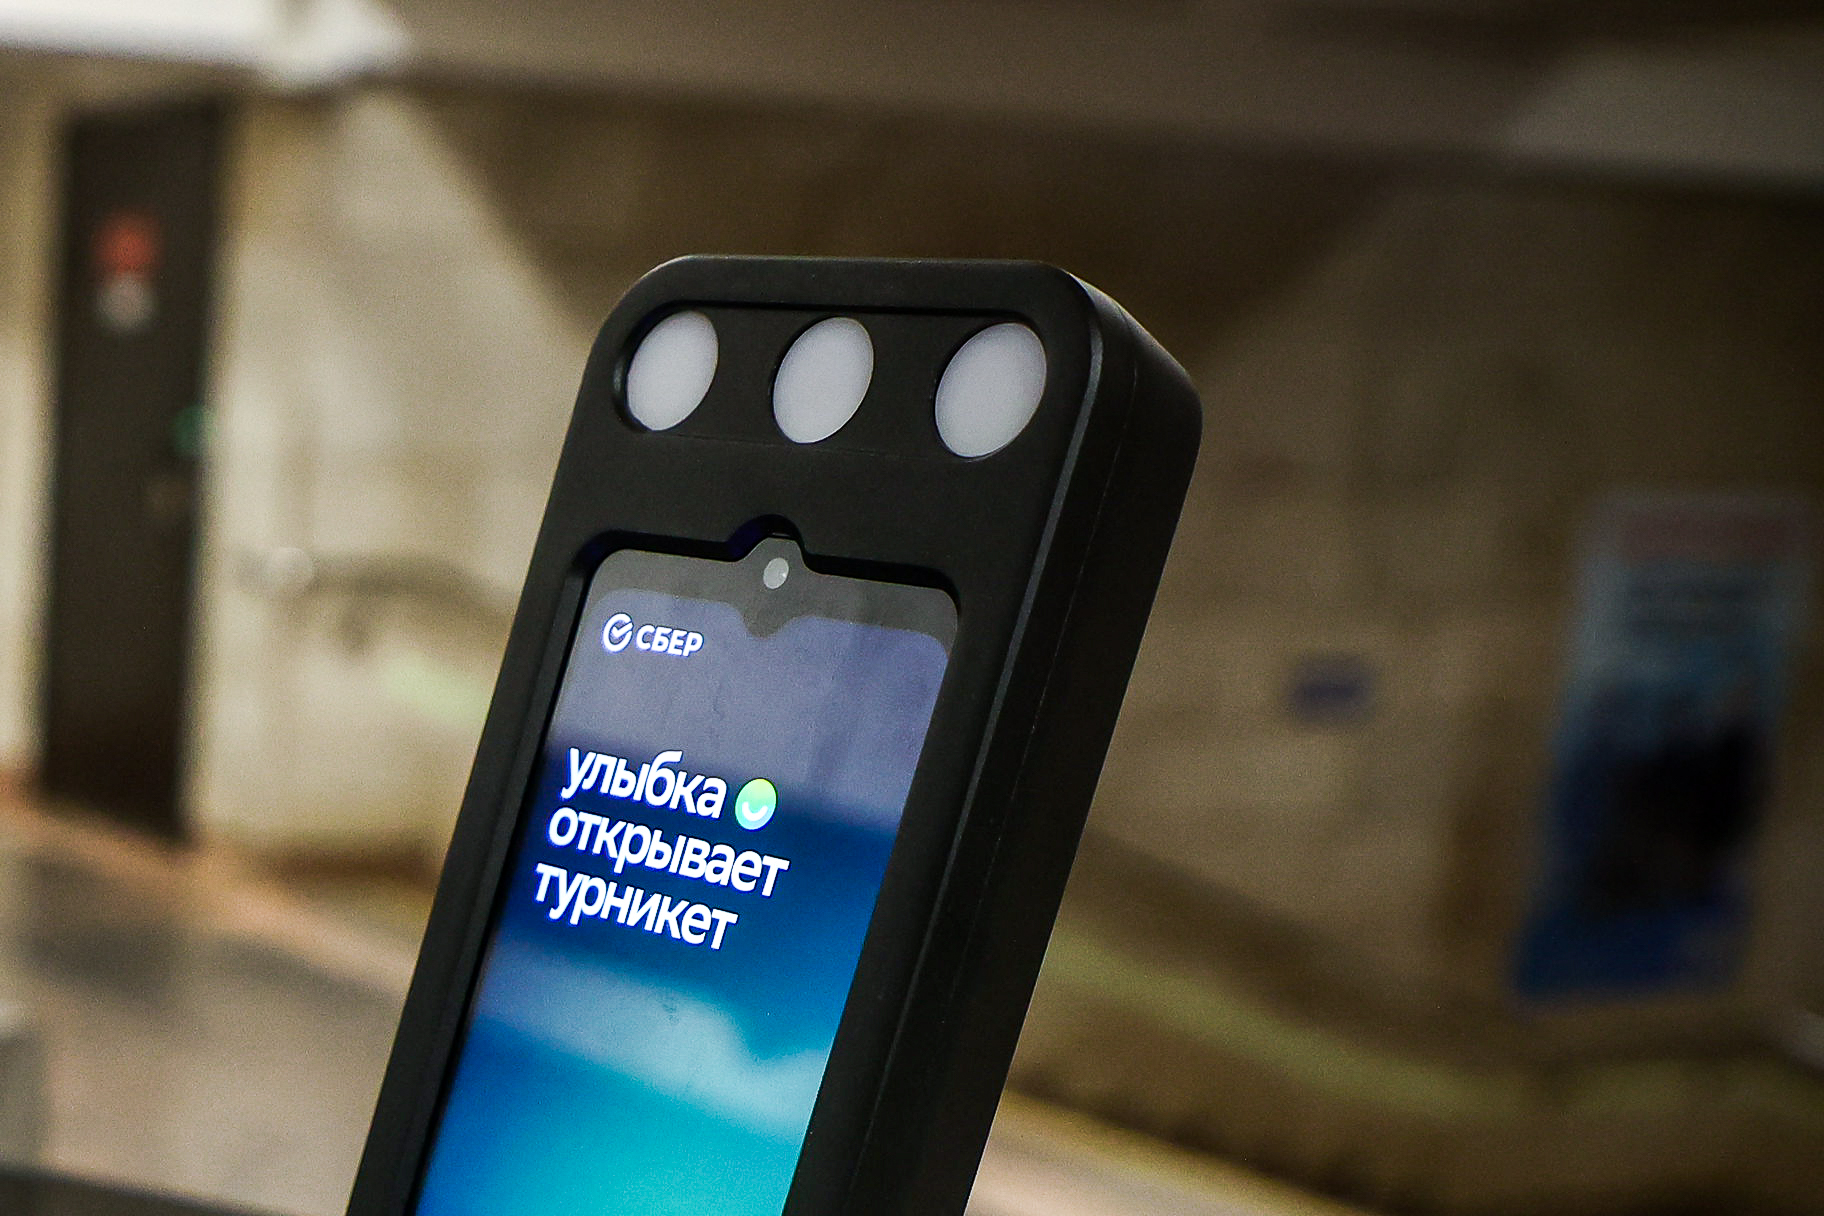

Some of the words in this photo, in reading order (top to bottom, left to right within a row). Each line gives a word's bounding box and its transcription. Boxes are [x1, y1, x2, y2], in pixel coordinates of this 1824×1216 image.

[635, 623, 704, 657] СБЕР
[559, 746, 728, 820] улыбка
[547, 806, 790, 898] открывает
[533, 861, 739, 951] турникет
